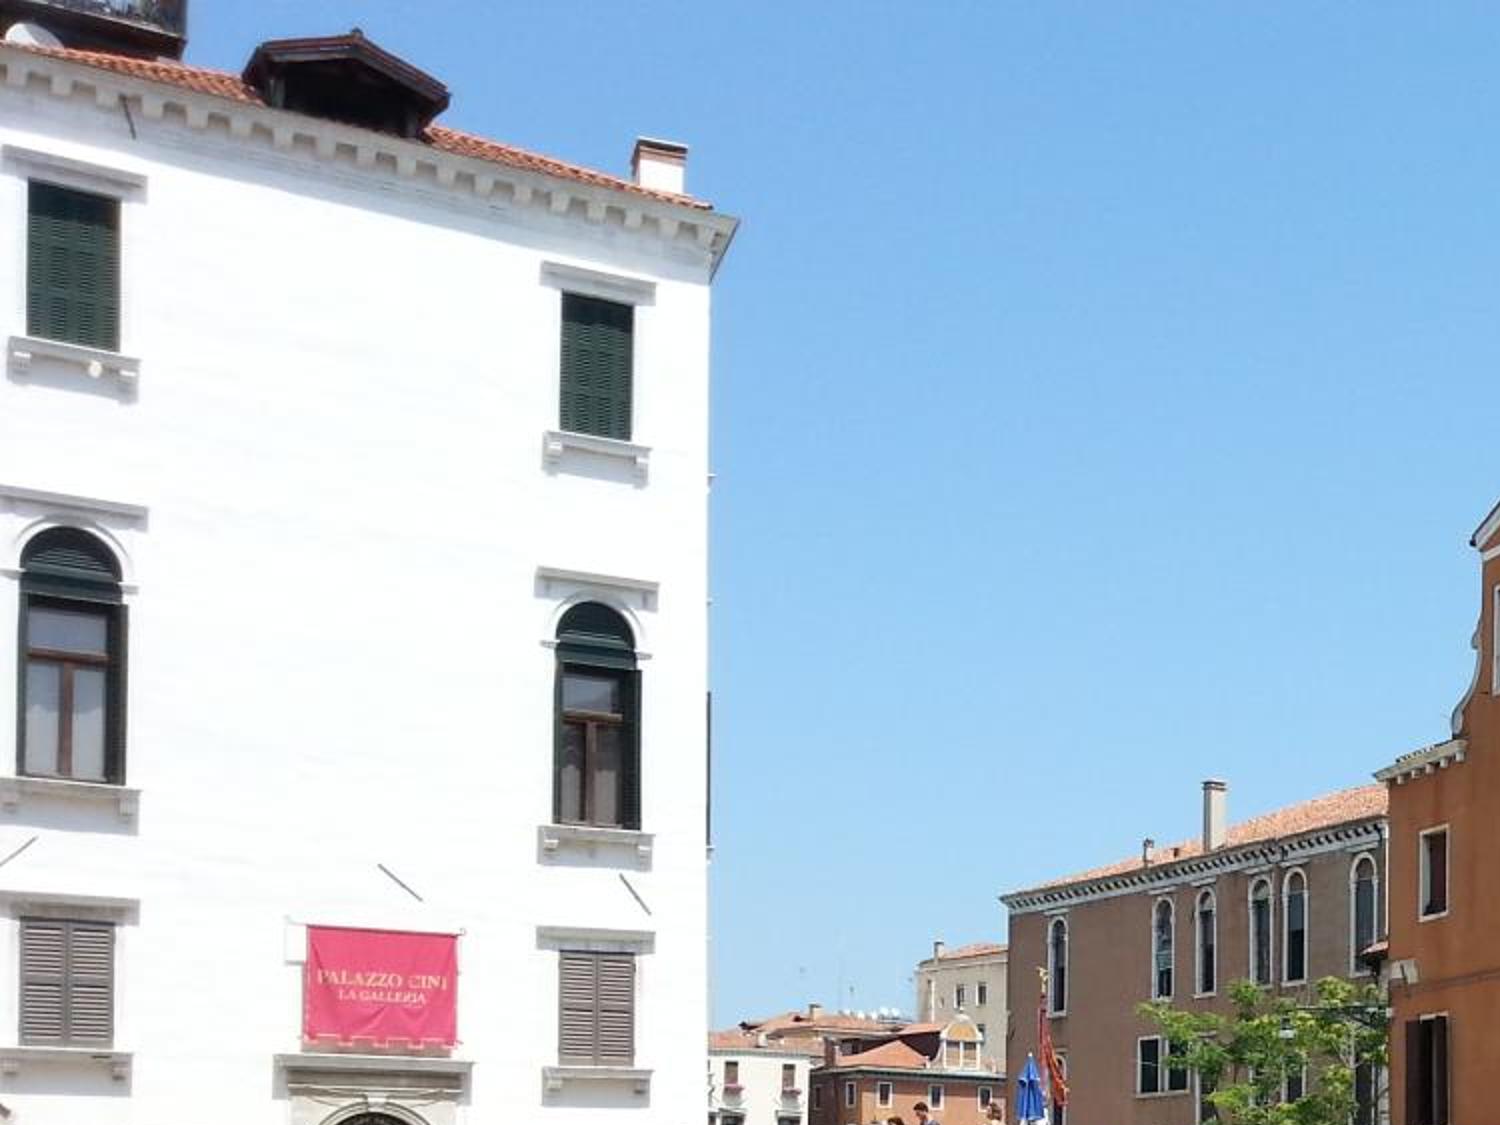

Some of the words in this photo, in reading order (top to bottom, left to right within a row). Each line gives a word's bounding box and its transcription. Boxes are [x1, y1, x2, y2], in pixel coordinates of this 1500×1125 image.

[317, 969, 403, 988] PALAZZO
[408, 974, 447, 991] CINI
[338, 988, 357, 1001] LA
